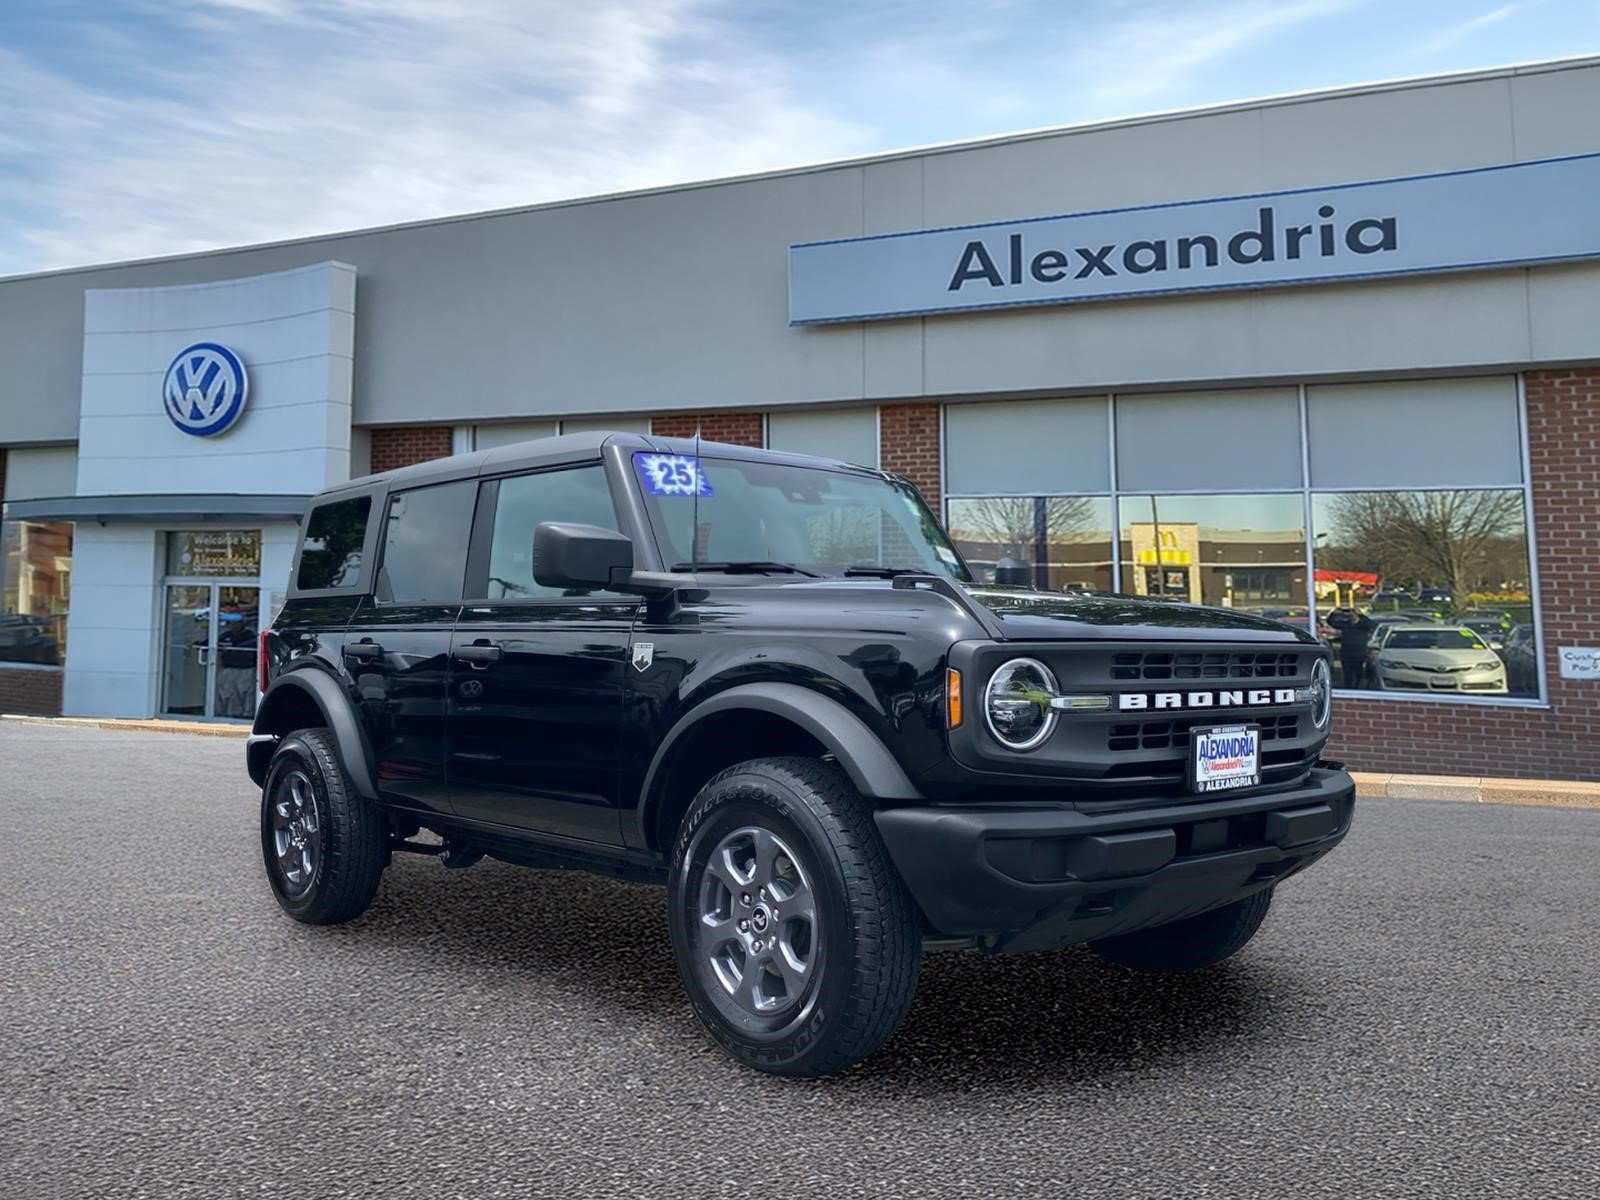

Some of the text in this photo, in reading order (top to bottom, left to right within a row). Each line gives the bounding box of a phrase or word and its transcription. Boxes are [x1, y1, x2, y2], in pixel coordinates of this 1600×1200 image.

[947, 204, 1398, 291] Alexandria
[657, 461, 692, 486] 25
[194, 535, 240, 545] Welcome
[1119, 688, 1296, 710] BRONCO
[1199, 736, 1255, 761] ALEXANDRIA
[1205, 776, 1252, 792] ALEXANDRIA
